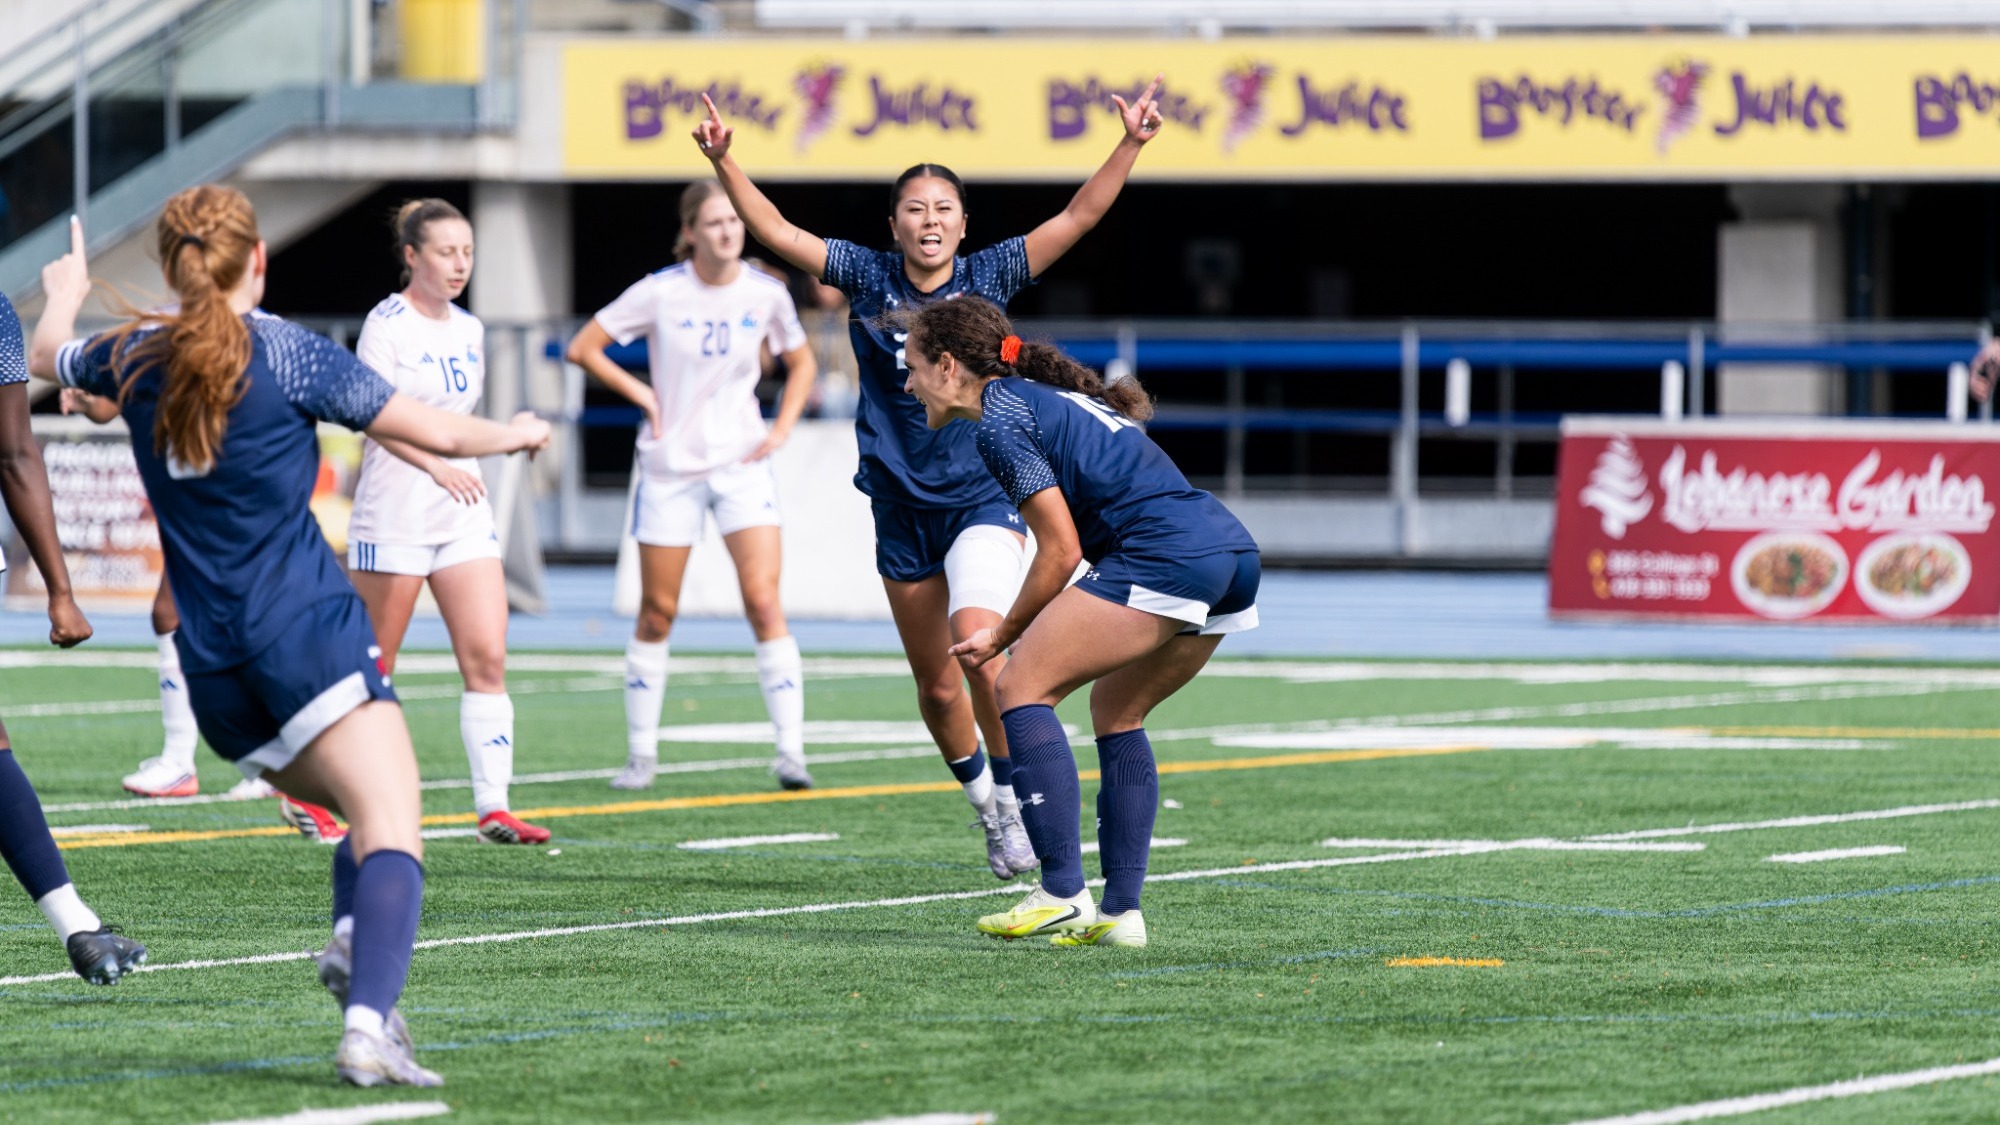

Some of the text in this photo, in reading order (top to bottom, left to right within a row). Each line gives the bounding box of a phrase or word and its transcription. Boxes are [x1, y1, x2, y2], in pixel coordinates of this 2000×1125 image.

[853, 77, 976, 136] Juice
[1280, 75, 1408, 135] Juice
[1479, 73, 1846, 138] Booster Juice
[1915, 74, 2000, 138] Boo
[703, 321, 730, 357] 20
[440, 356, 468, 393] 16
[1660, 443, 1996, 533] Lebanese Garden
